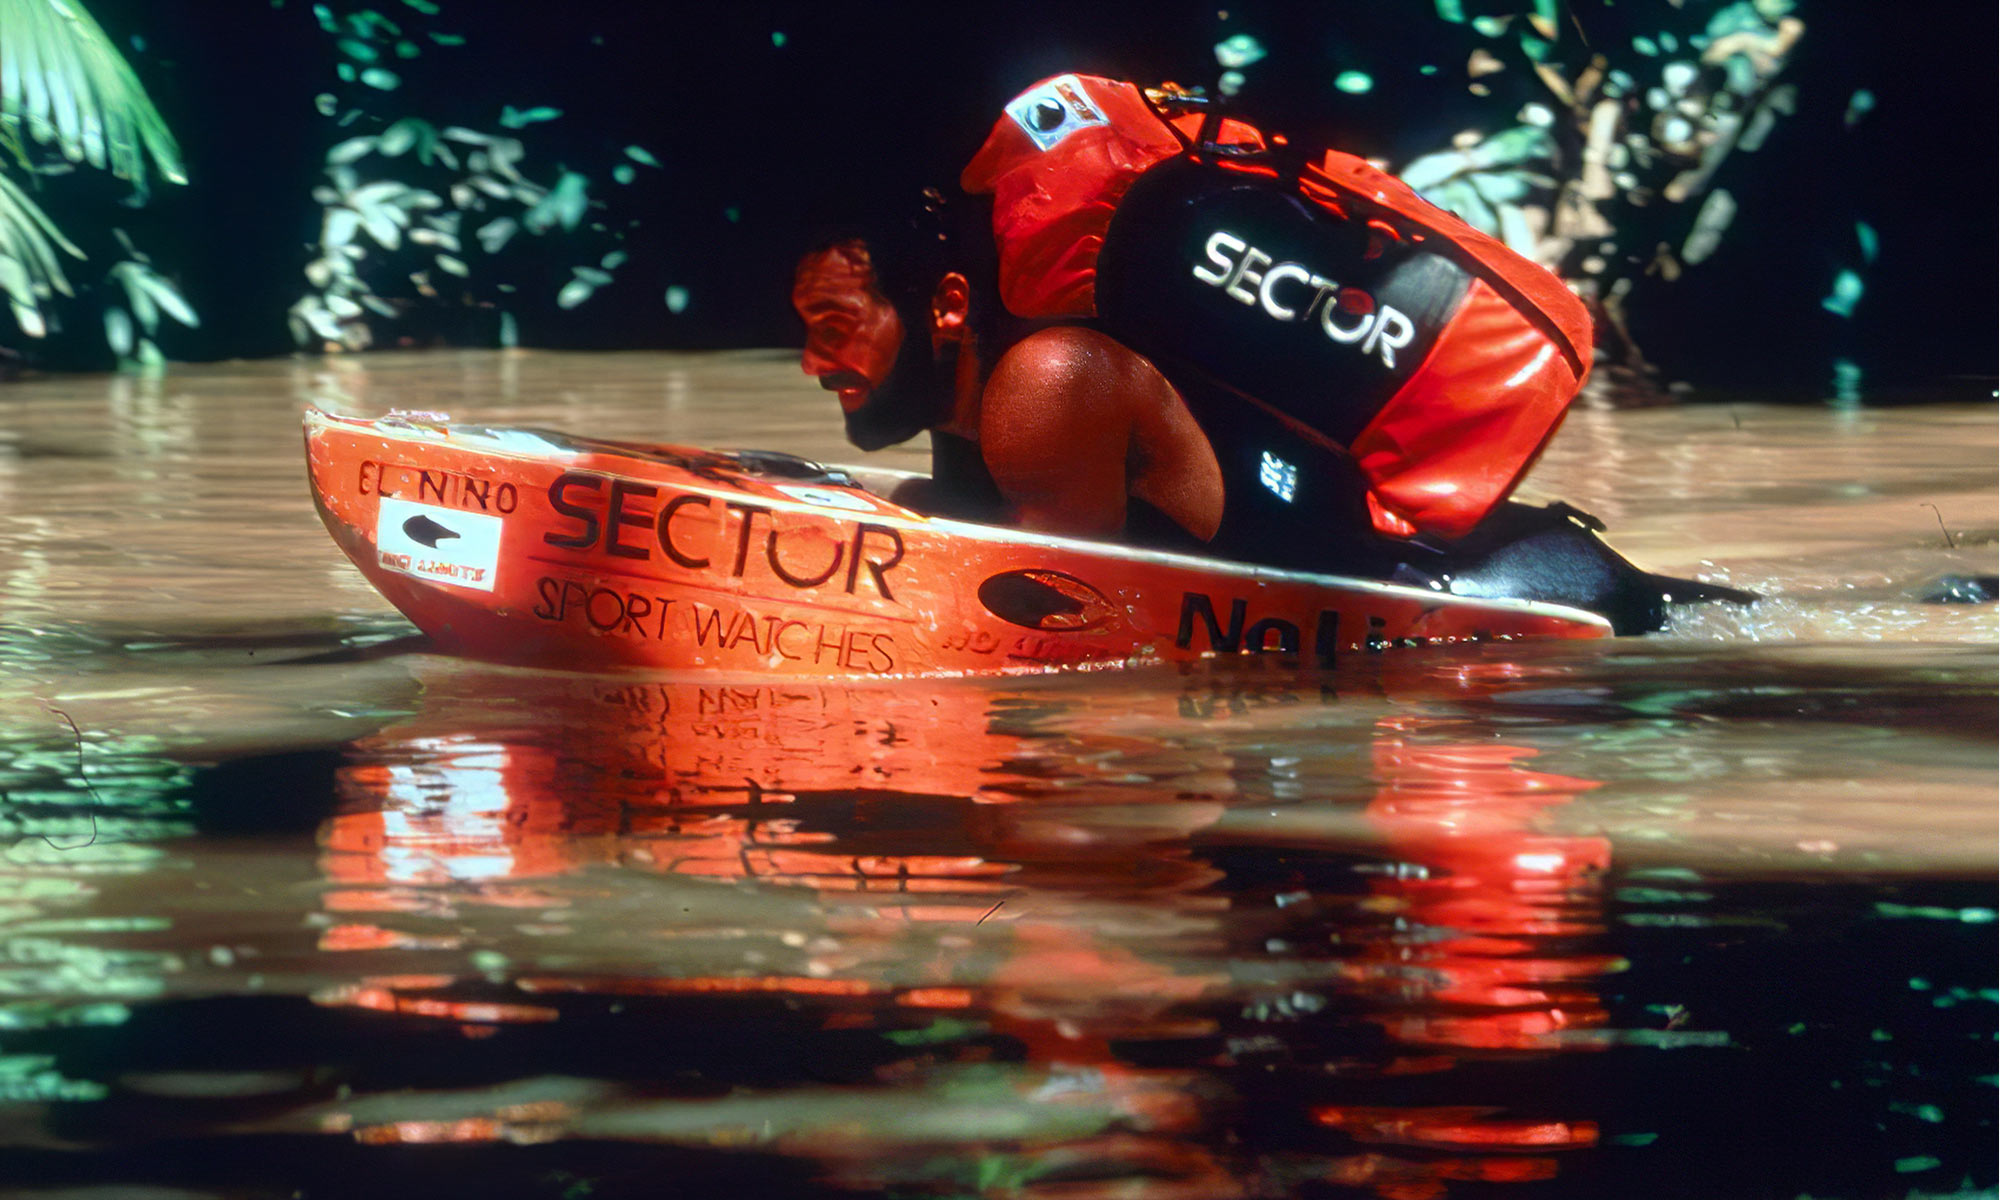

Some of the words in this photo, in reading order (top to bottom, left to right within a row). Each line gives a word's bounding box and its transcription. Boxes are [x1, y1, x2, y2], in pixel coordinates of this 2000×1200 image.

[1193, 231, 1415, 369] SECTOR
[359, 460, 395, 498] EL
[543, 473, 905, 601] SECTOR
[534, 577, 676, 641] SPORT
[693, 601, 894, 674] WATCHES
